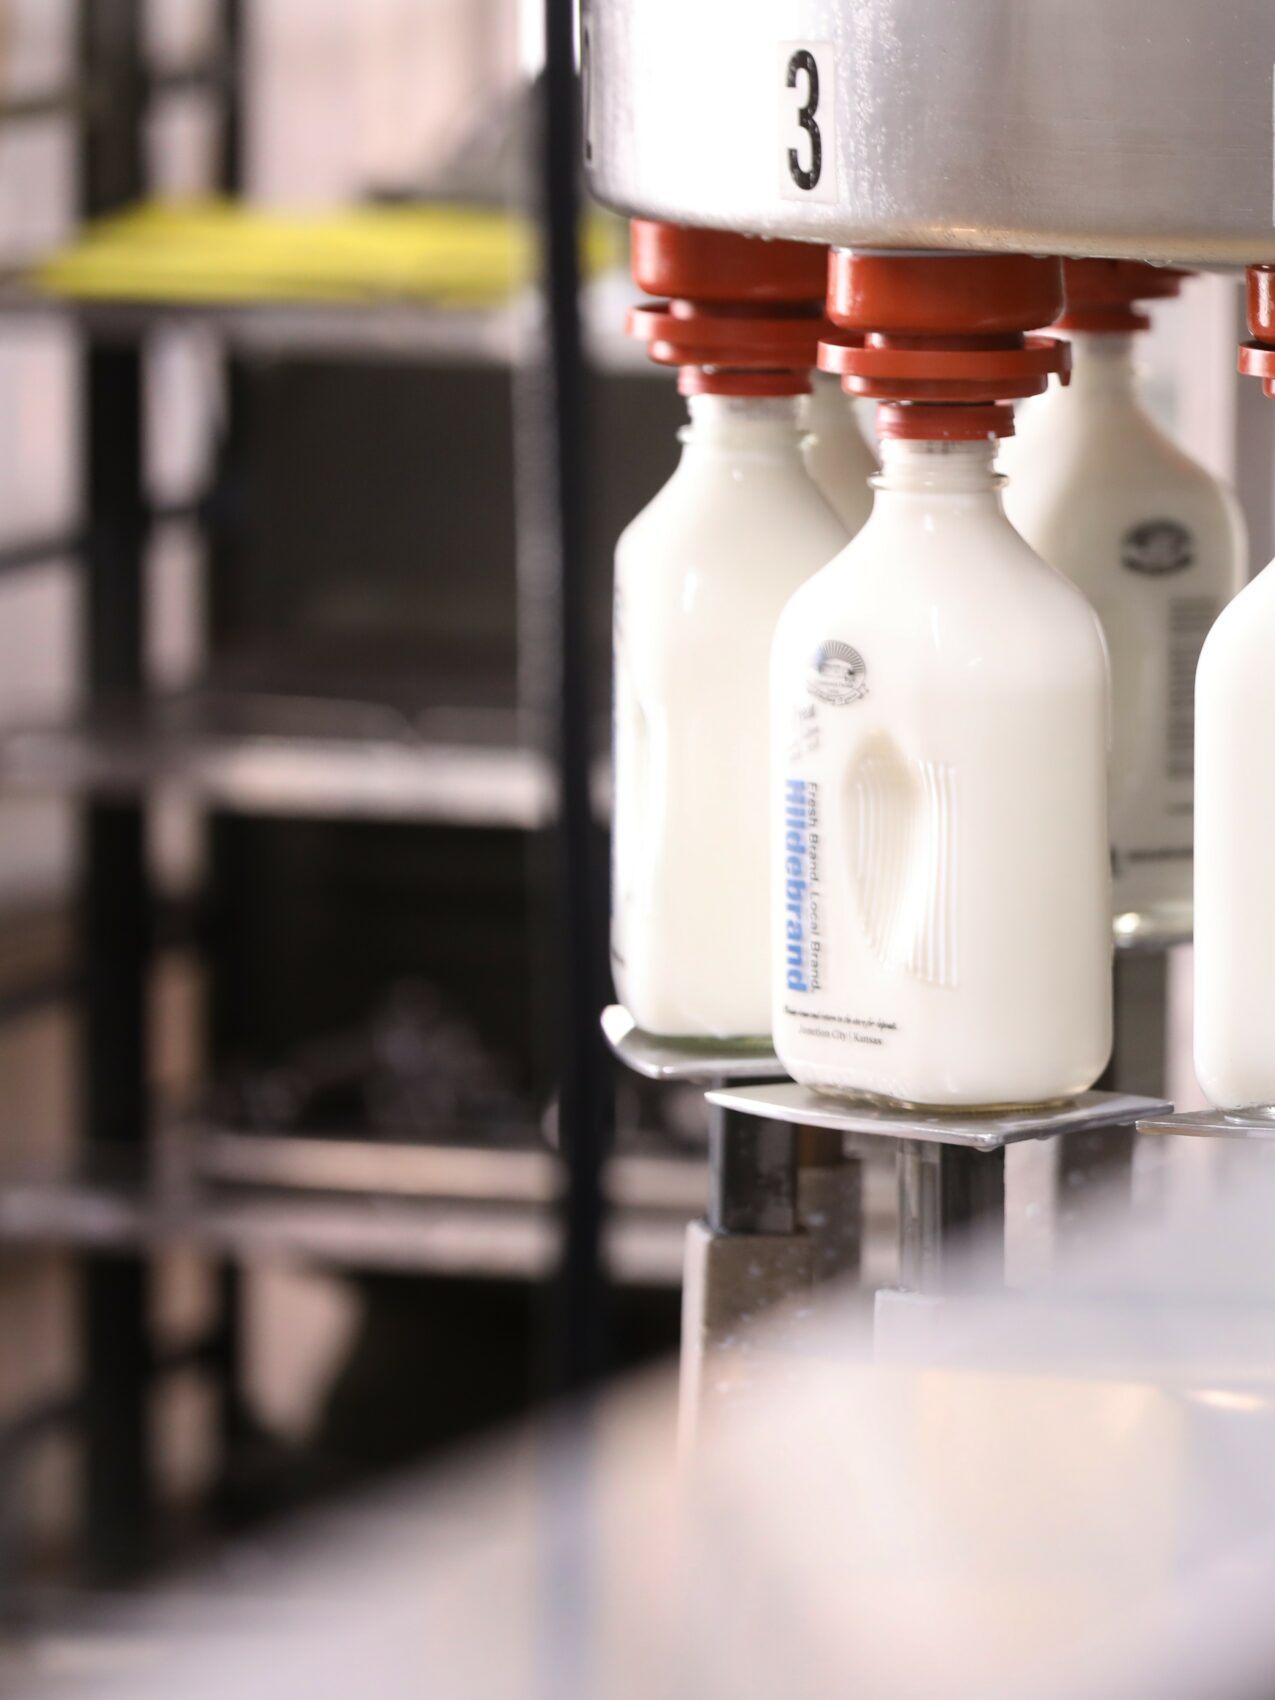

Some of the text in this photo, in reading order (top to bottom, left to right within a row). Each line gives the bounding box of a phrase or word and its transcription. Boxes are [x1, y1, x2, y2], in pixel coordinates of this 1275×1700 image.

[786, 49, 822, 191] 3
[807, 782, 818, 828] Fresh
[786, 779, 807, 992] Hildebrand
[810, 891, 821, 937] Local
